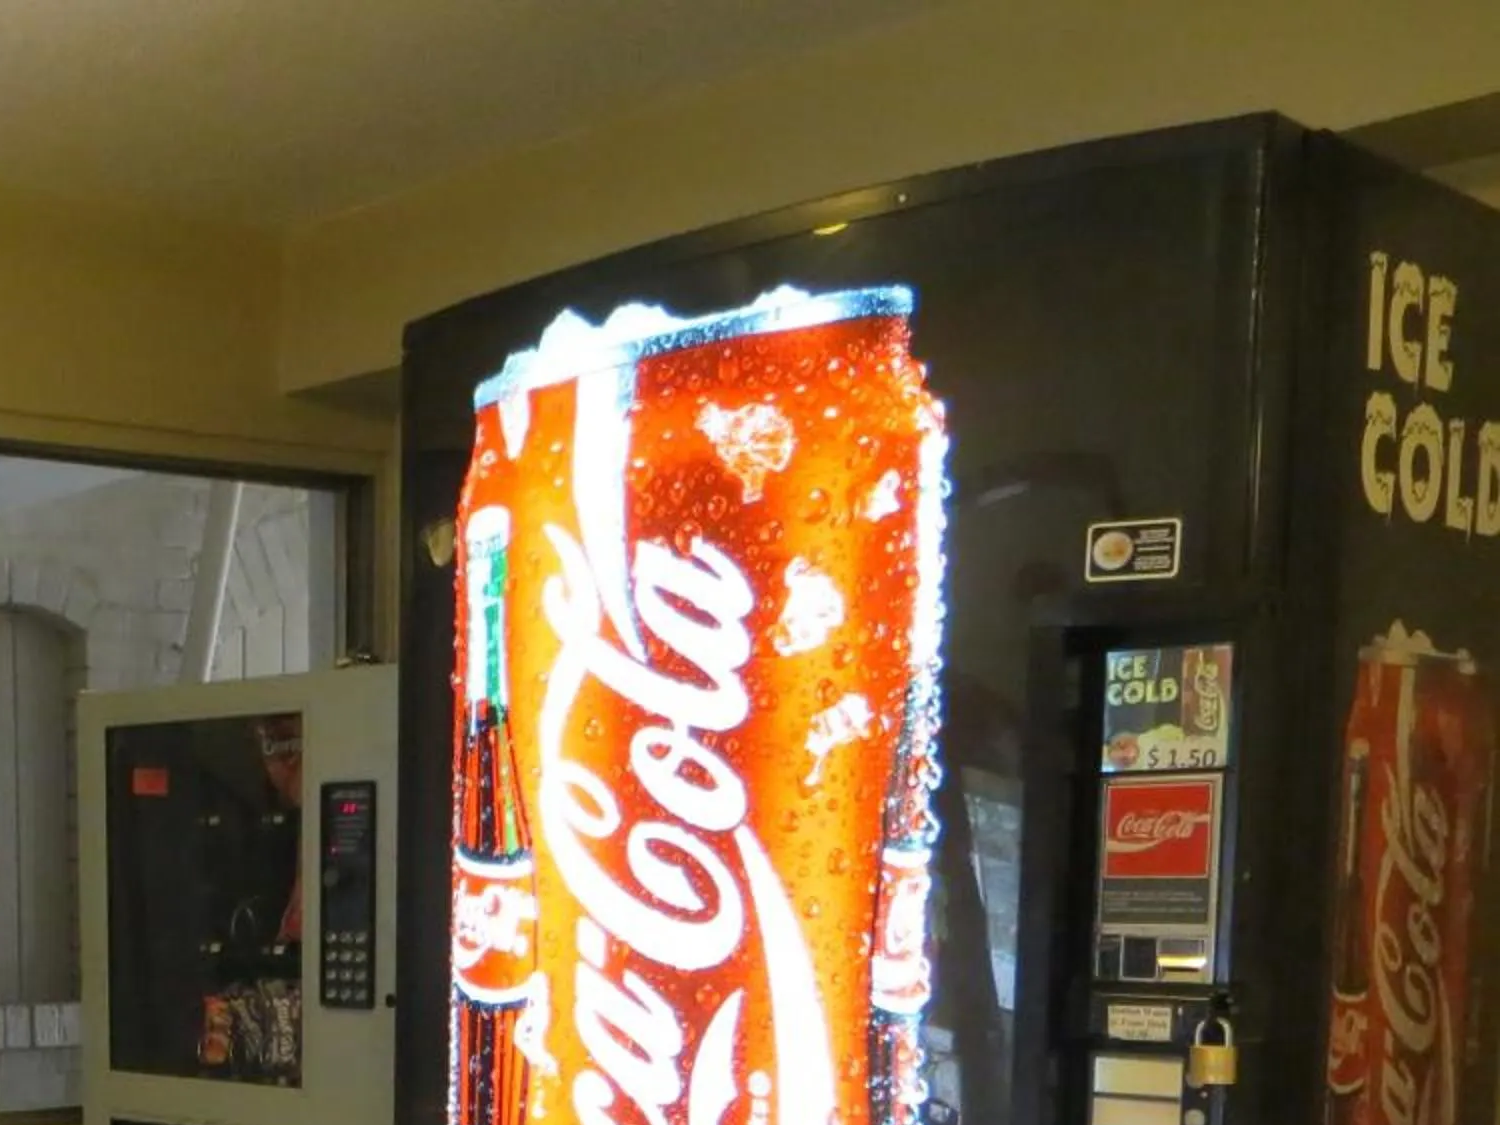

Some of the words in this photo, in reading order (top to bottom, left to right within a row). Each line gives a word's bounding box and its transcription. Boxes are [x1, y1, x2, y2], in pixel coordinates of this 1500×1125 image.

[1367, 250, 1457, 394] ICE
[1360, 391, 1500, 540] COLD
[1107, 678, 1179, 706] COLD
[1108, 656, 1148, 681] ICE
